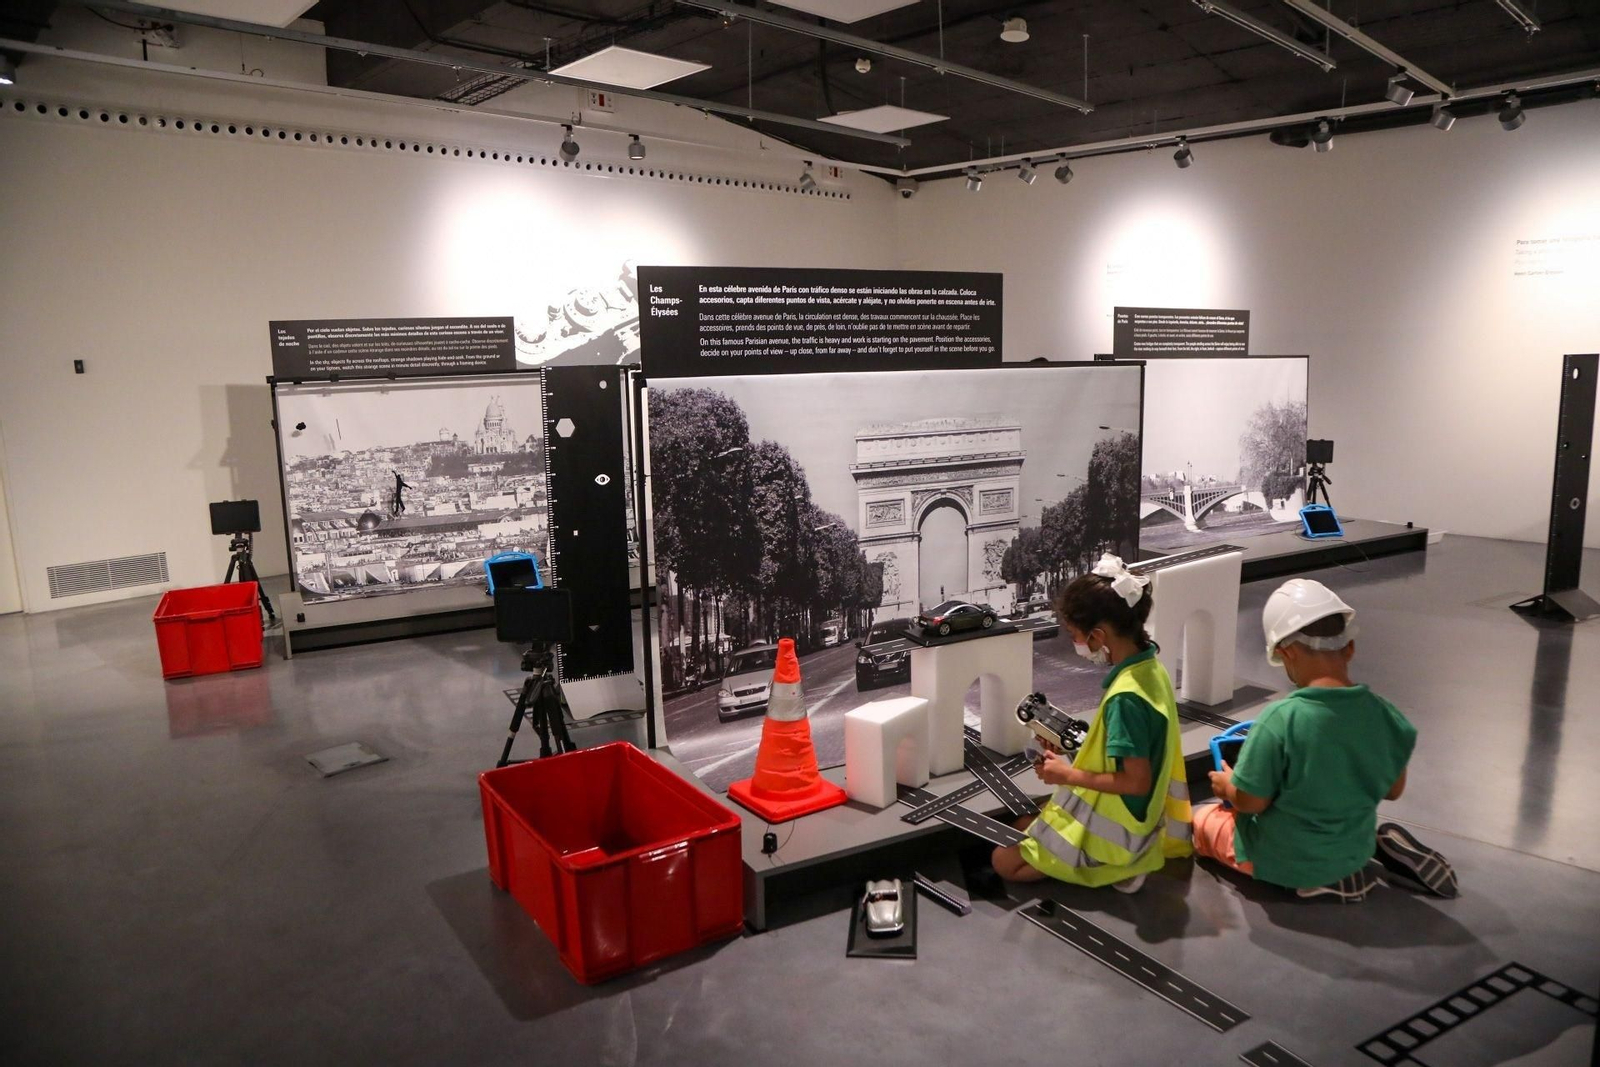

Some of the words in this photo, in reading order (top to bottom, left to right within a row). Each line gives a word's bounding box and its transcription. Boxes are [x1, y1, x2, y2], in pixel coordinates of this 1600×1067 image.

[650, 284, 662, 293] Les
[699, 285, 708, 293] En
[708, 285, 722, 293] esta
[724, 285, 747, 293] célebre
[748, 286, 772, 294] avenida
[773, 286, 781, 294] de
[650, 296, 683, 305] Champs-
[699, 296, 735, 305] accesorios,
[736, 296, 754, 306] capta
[786, 297, 807, 306] puntos
[863, 298, 883, 306] aléjate,
[917, 298, 937, 307] ponerte
[651, 306, 678, 316] Élysées
[783, 313, 798, 321] Paris,
[700, 323, 734, 332] accessoires,
[735, 323, 755, 333] prends
[767, 323, 784, 332] points
[814, 323, 827, 332] près,
[836, 323, 847, 331] loin,
[825, 337, 840, 346] heavy
[872, 337, 892, 345] starting
[909, 336, 934, 345] pavement.
[744, 348, 762, 357] points
[883, 347, 898, 355] forget
